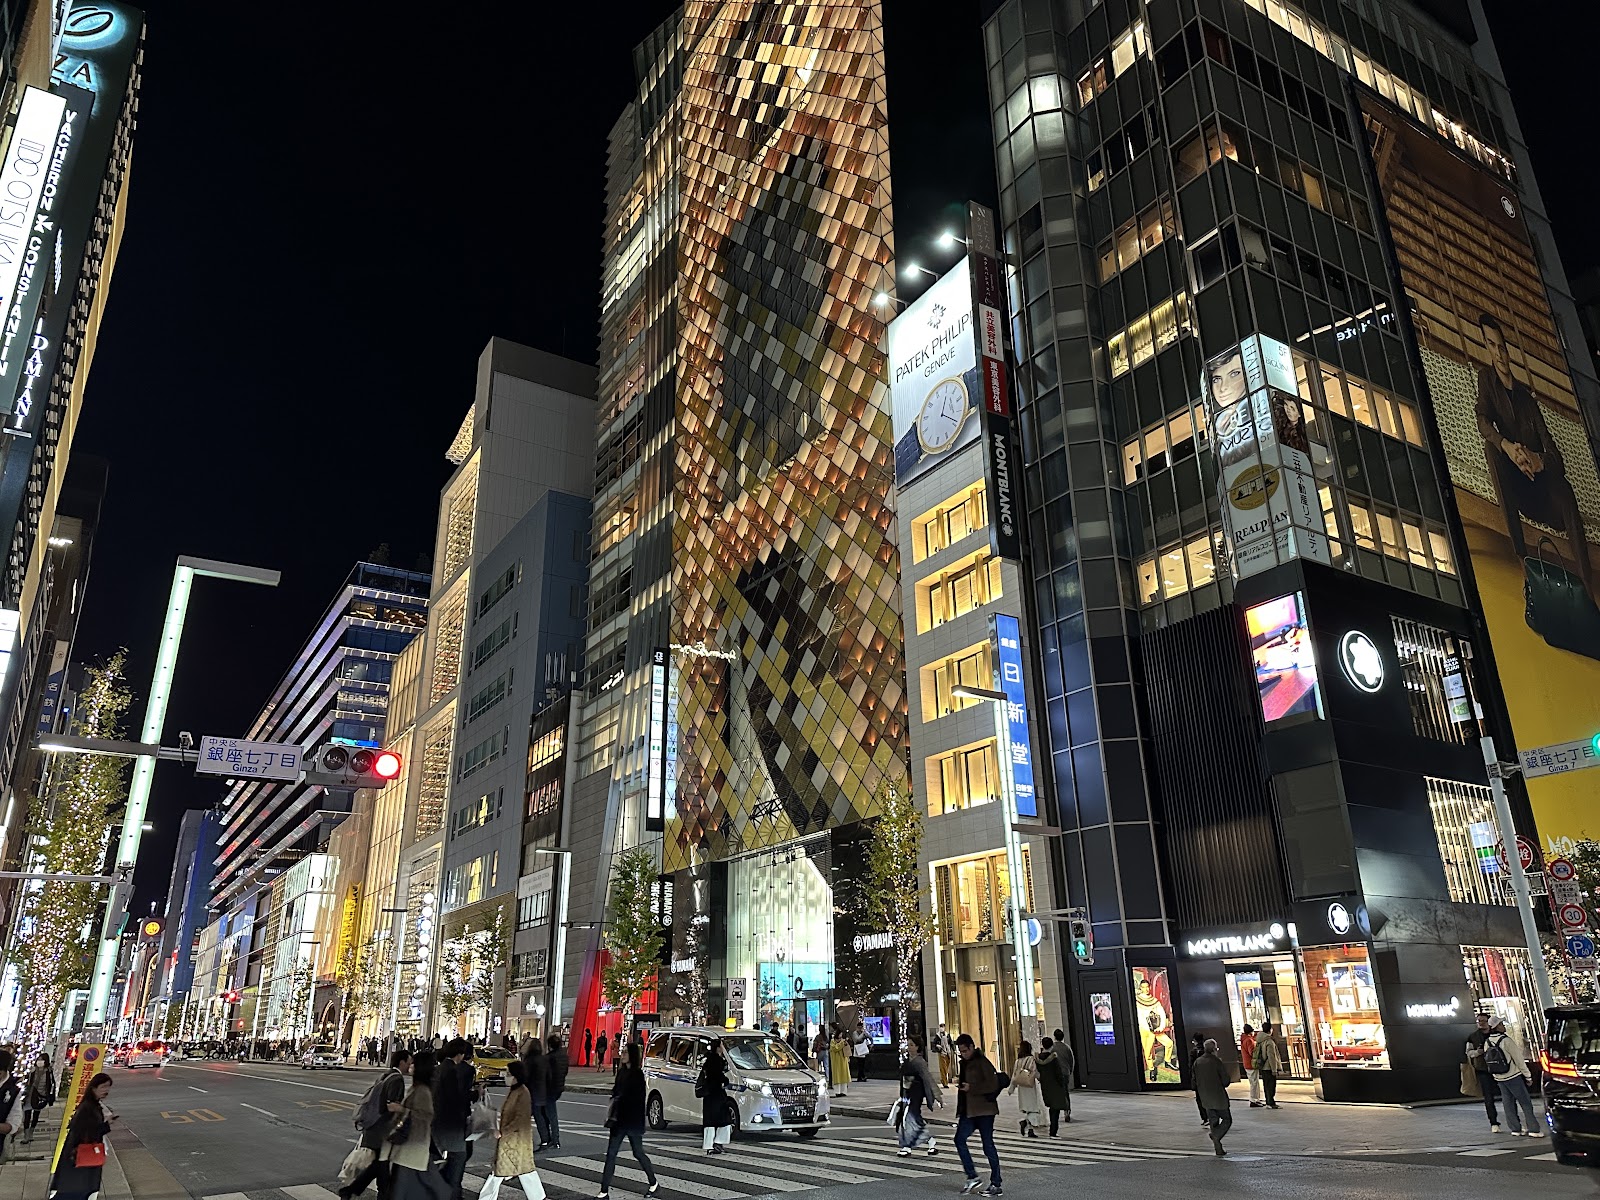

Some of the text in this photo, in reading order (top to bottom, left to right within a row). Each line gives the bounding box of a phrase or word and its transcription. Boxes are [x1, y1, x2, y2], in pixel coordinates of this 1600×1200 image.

[14, 138, 46, 176] IDC
[0, 109, 78, 376] VACHERON CONSTANTIN
[985, 310, 998, 356] 共立美容外科
[895, 345, 930, 383] PATEK
[923, 346, 956, 378] GENEVE
[1244, 343, 1261, 385] HAIR
[14, 335, 49, 429] DAMIANI
[990, 361, 1002, 413] 東京美容外科
[994, 433, 1012, 524] MONTBLANC
[1003, 662, 1029, 765] 日新堂
[208, 738, 237, 748] 中央区
[1523, 748, 1545, 757] 中央区
[206, 746, 296, 768] 銀座七丁目
[232, 763, 268, 774] Ginza 7
[1526, 745, 1595, 769] 銀座七丁目
[1548, 764, 1569, 773] Ginza
[1566, 910, 1581, 920] 30
[862, 932, 894, 950] YAMAHA
[1187, 933, 1276, 955] MONTBLANC
[1572, 941, 1583, 955] P
[160, 1108, 227, 1124] 50
